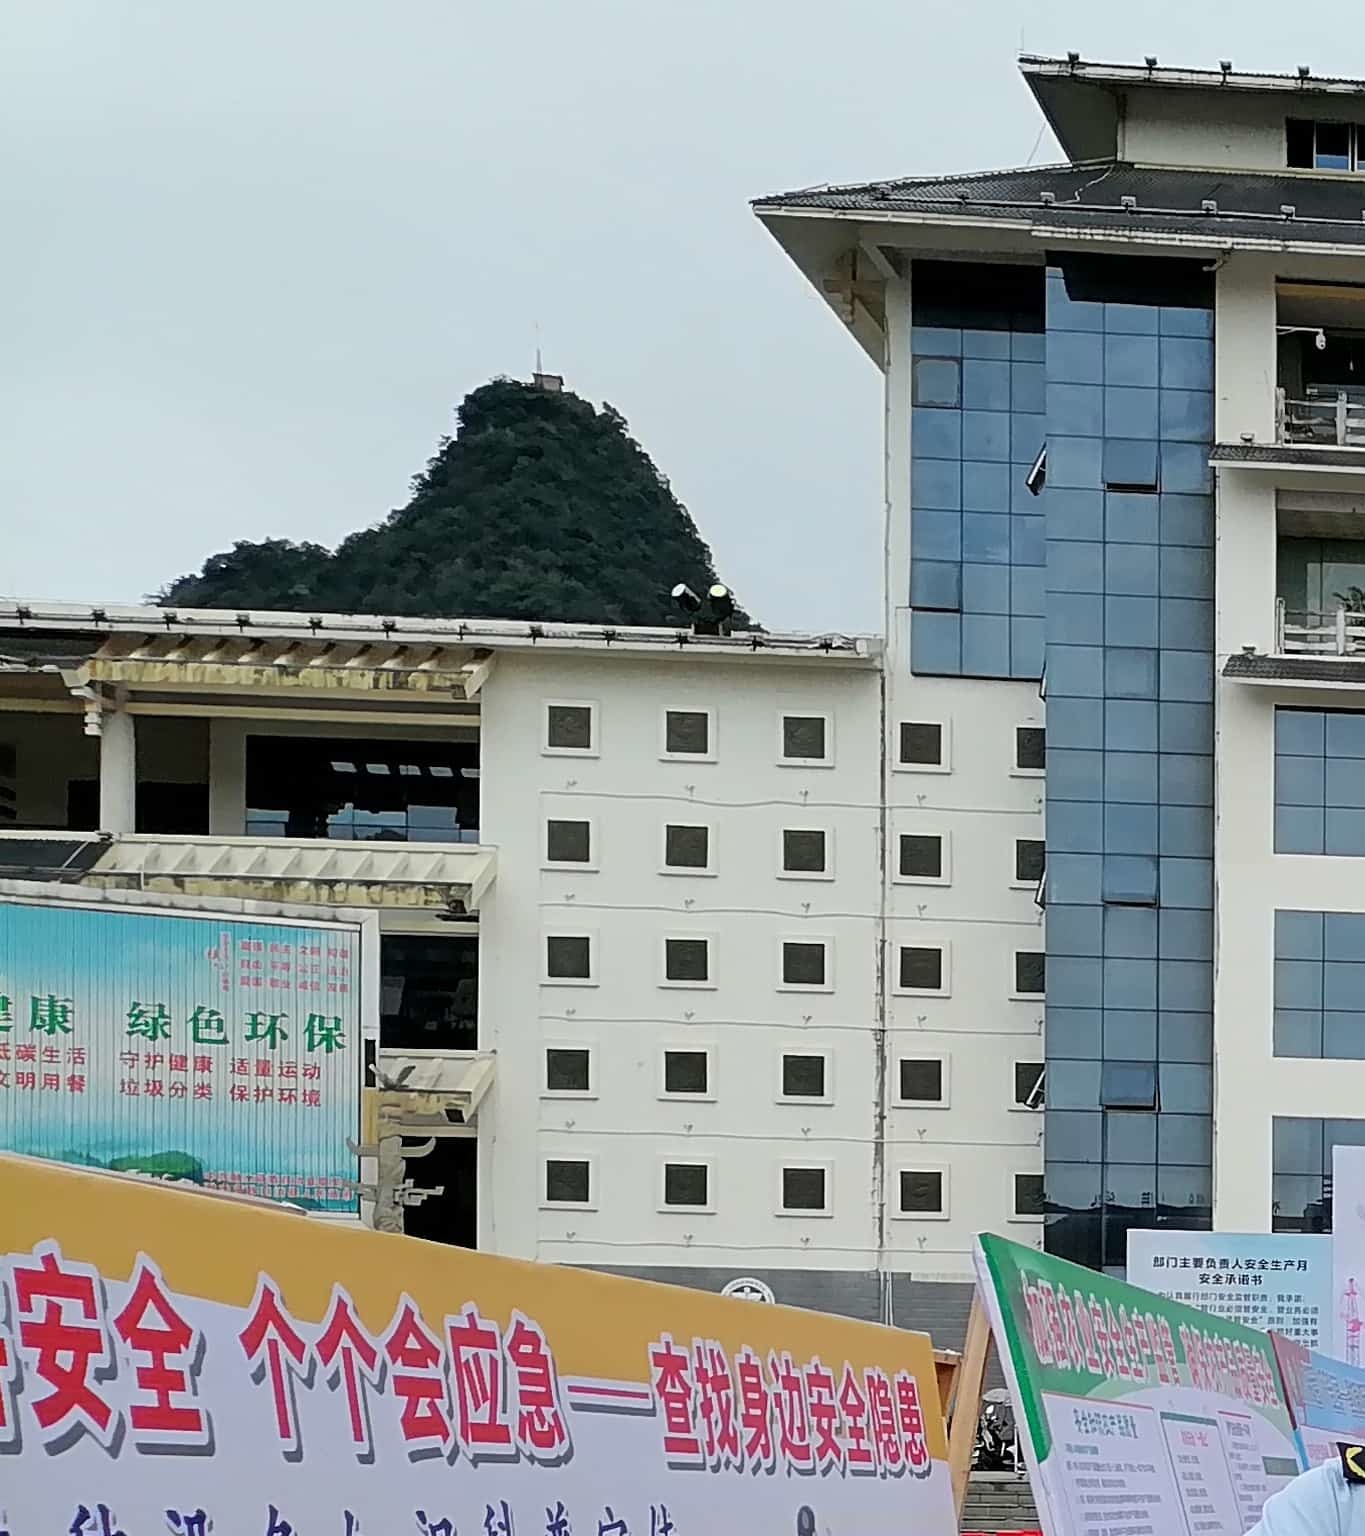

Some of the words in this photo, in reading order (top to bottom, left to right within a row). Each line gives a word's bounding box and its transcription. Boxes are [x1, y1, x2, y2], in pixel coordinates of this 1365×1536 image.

[126, 1002, 347, 1053] 绿色环保
[119, 1051, 213, 1074] 守护健康
[229, 1057, 322, 1080] 适量运动
[120, 1078, 213, 1100] 垃圾分类
[230, 1084, 322, 1107] 保护环境
[1153, 1256, 1307, 1271] 部门主要负责人安全生产月
[1199, 1273, 1262, 1285] 安全承诺书
[0, 1253, 203, 1433] 安全
